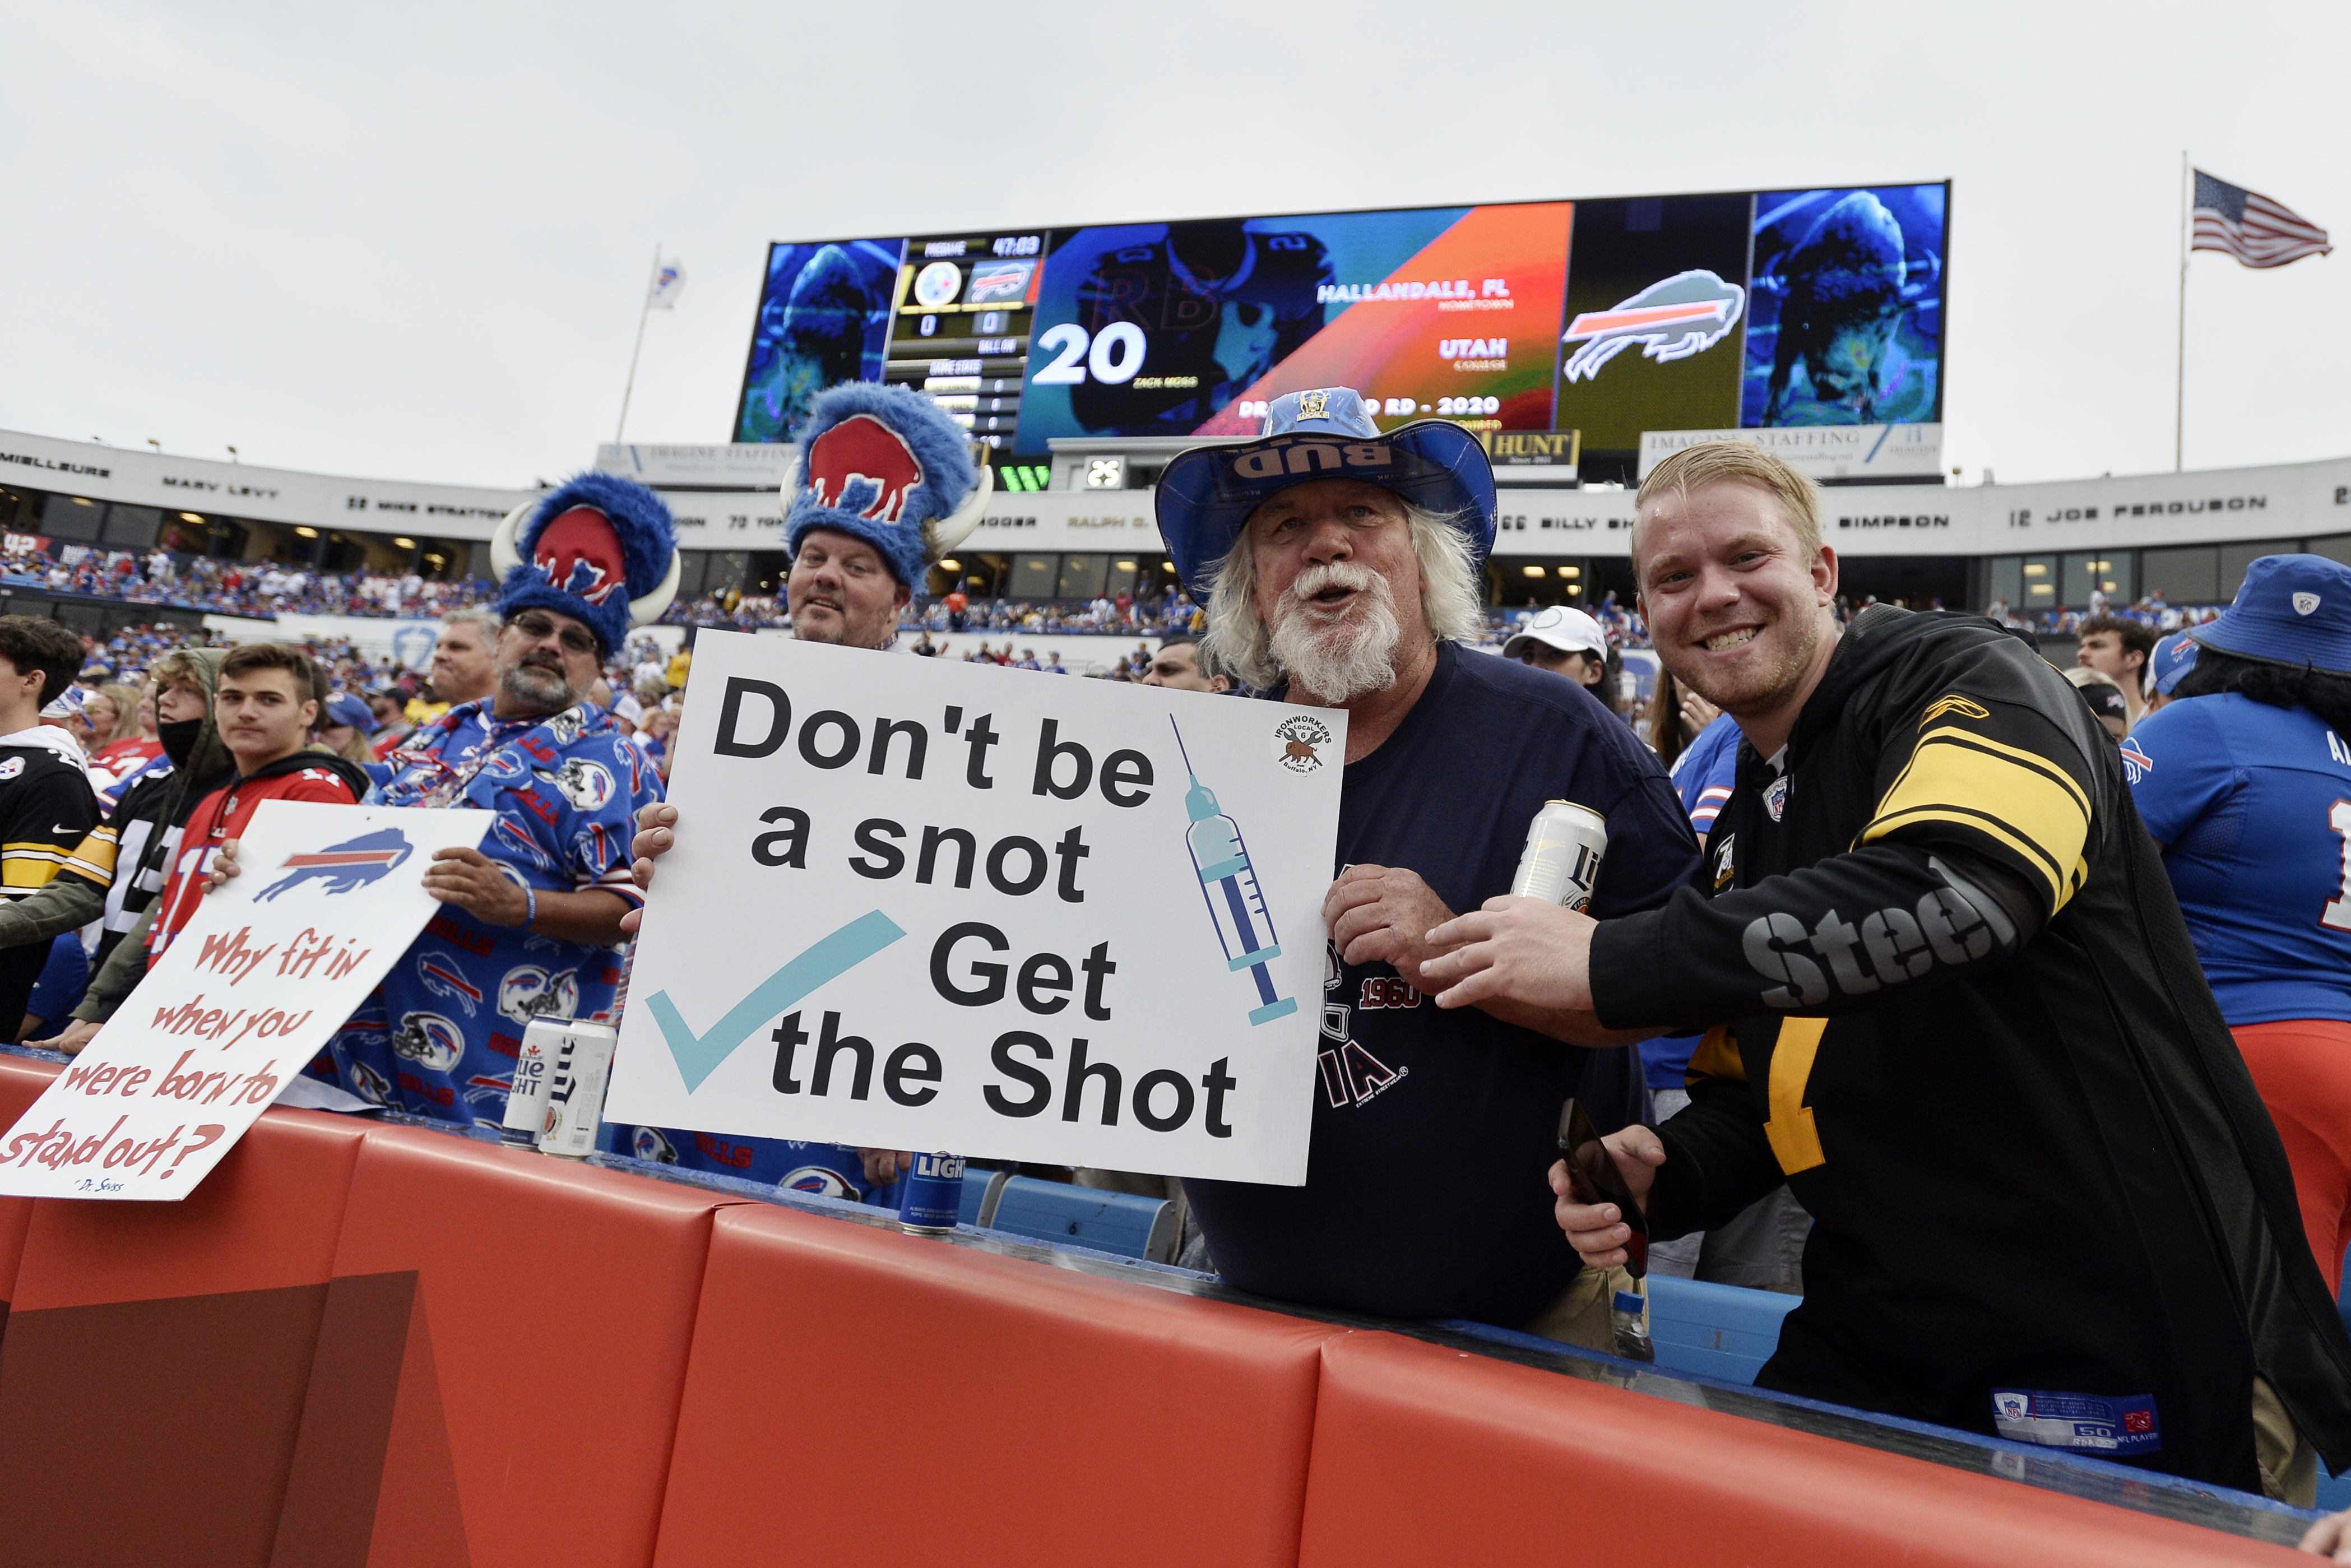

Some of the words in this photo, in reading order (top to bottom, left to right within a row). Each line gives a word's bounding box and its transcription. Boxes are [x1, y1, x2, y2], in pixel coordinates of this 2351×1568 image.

[993, 235, 1040, 257] 47:03
[1317, 280, 1476, 304] HALLANDALE,
[1482, 279, 1510, 297] FL
[920, 314, 936, 336] 0
[983, 312, 999, 334] 0
[1032, 321, 1147, 385] 20
[1439, 337, 1508, 359] UTAH
[1384, 397, 1416, 416] RD
[1436, 396, 1500, 415] 2020
[1494, 434, 1569, 457] HUNT
[1756, 430, 1860, 447] STAFFING
[1234, 443, 1392, 478] BUD
[163, 476, 220, 493] MARV
[227, 485, 279, 500] LEVY
[1067, 516, 1125, 528] RALPH
[1541, 516, 1596, 529] BILLY
[1839, 514, 1949, 528] SIMPSON
[2011, 509, 2031, 527] 12
[2046, 507, 2099, 523] JOE
[2114, 494, 2267, 518] FERGUSON
[714, 676, 999, 790] Don't
[1032, 718, 1154, 807] be
[1274, 715, 1332, 744] IRONWORKERS
[1283, 762, 1307, 773] Buffalo,
[752, 807, 810, 869] a
[848, 819, 1090, 903] snot
[196, 926, 279, 987] Why
[277, 927, 335, 980] fit
[930, 922, 1116, 1020] Get
[1359, 977, 1422, 1010] 1960
[151, 995, 247, 1041] when
[221, 1007, 314, 1051] you
[62, 1063, 152, 1097] were
[152, 1049, 236, 1106] born
[229, 1059, 278, 1106] to
[772, 1010, 942, 1107] the
[984, 1031, 1237, 1138] Shot
[1356, 1093, 1375, 1108] EXTREME
[1375, 1074, 1402, 1096] STREETWEAR
[103, 1115, 226, 1180] out?
[78, 1179, 94, 1191] Dr.
[95, 1177, 126, 1192] Seuss
[2080, 1426, 2112, 1438] 50
[2117, 1435, 2130, 1444] NFL
